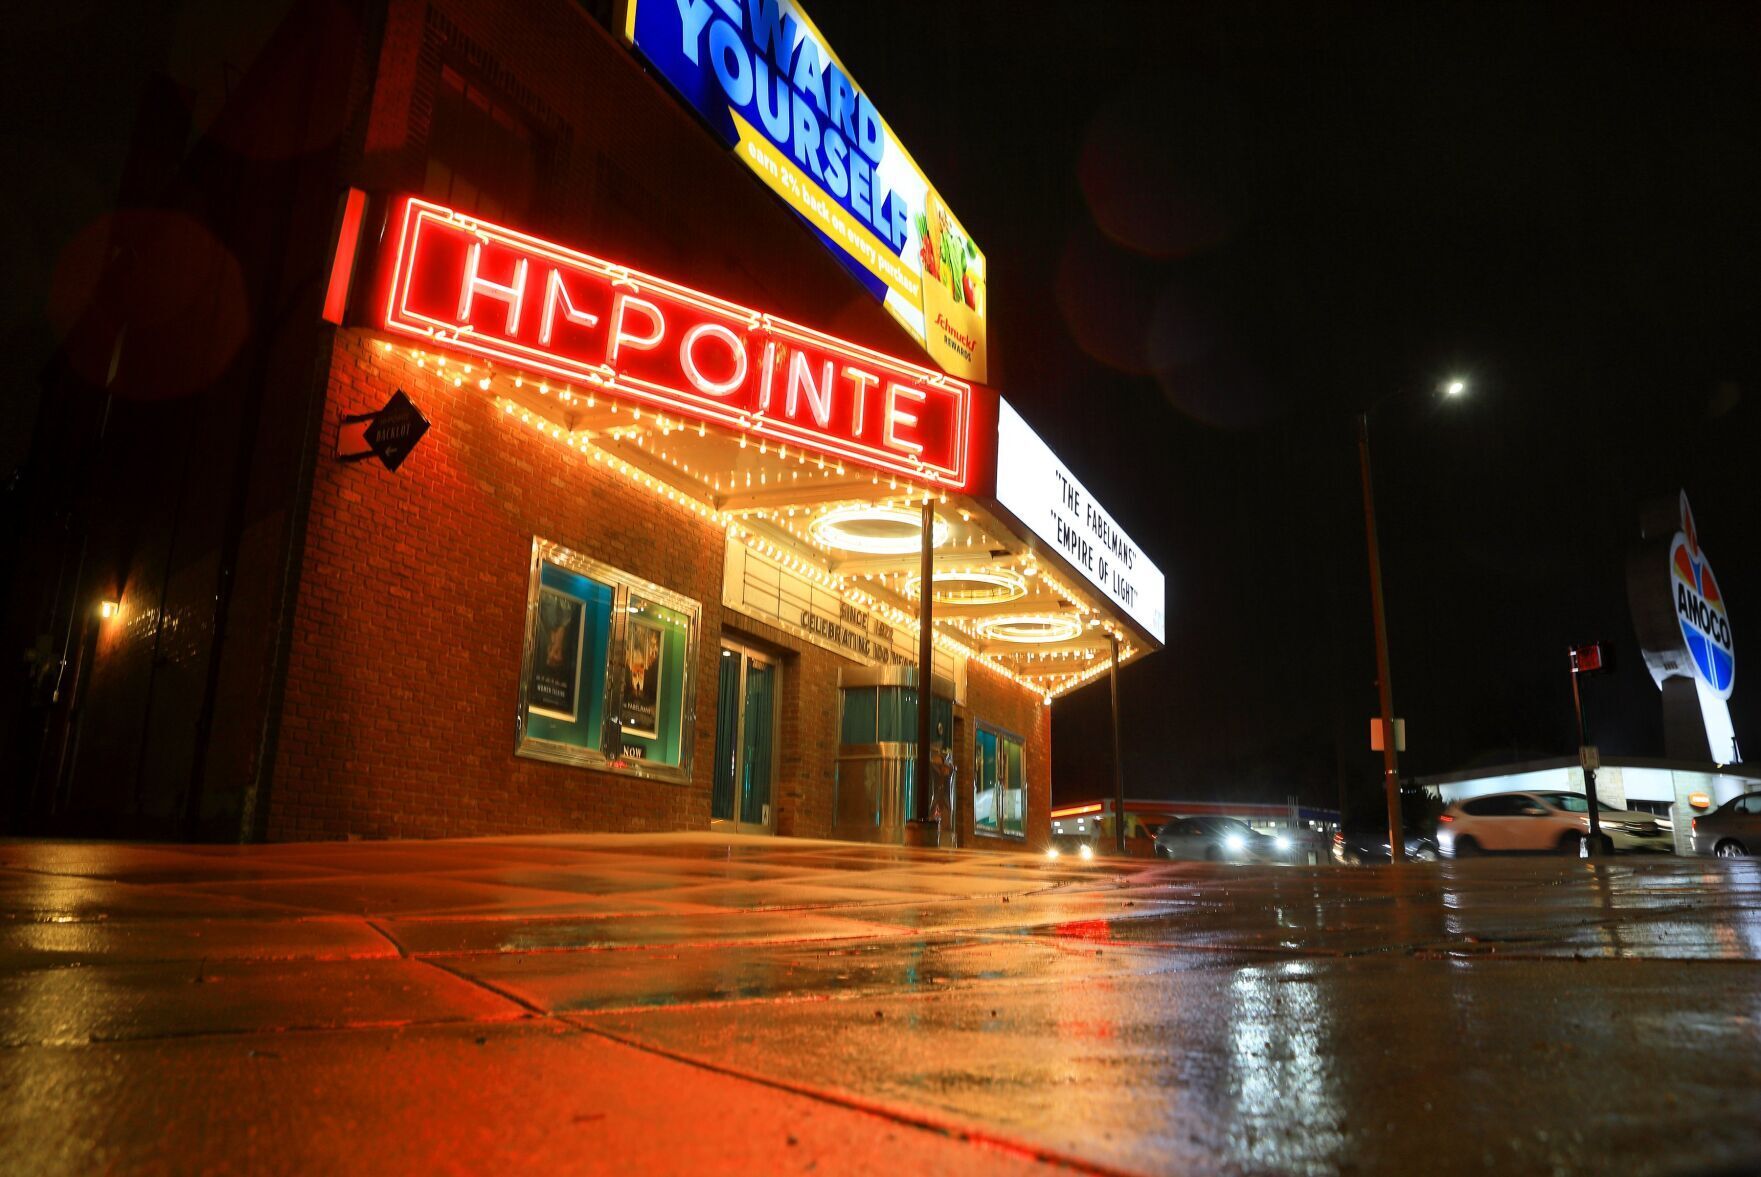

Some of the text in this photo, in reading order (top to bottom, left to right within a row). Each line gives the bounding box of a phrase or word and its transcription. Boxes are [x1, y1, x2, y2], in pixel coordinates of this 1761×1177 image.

[676, 0, 907, 251] YOURSELF
[748, 141, 778, 178] earn
[780, 165, 801, 197] 2%
[801, 184, 830, 224] back
[831, 215, 847, 237] on
[847, 229, 877, 265] every
[456, 242, 927, 458] HI-POINTE
[934, 312, 977, 352] Schnucks
[943, 334, 972, 362] REWARDS
[1098, 556, 1109, 584] OF
[801, 609, 871, 657] CELEBRATING
[1678, 582, 1731, 650] AMOCO
[623, 744, 643, 759] NOW
